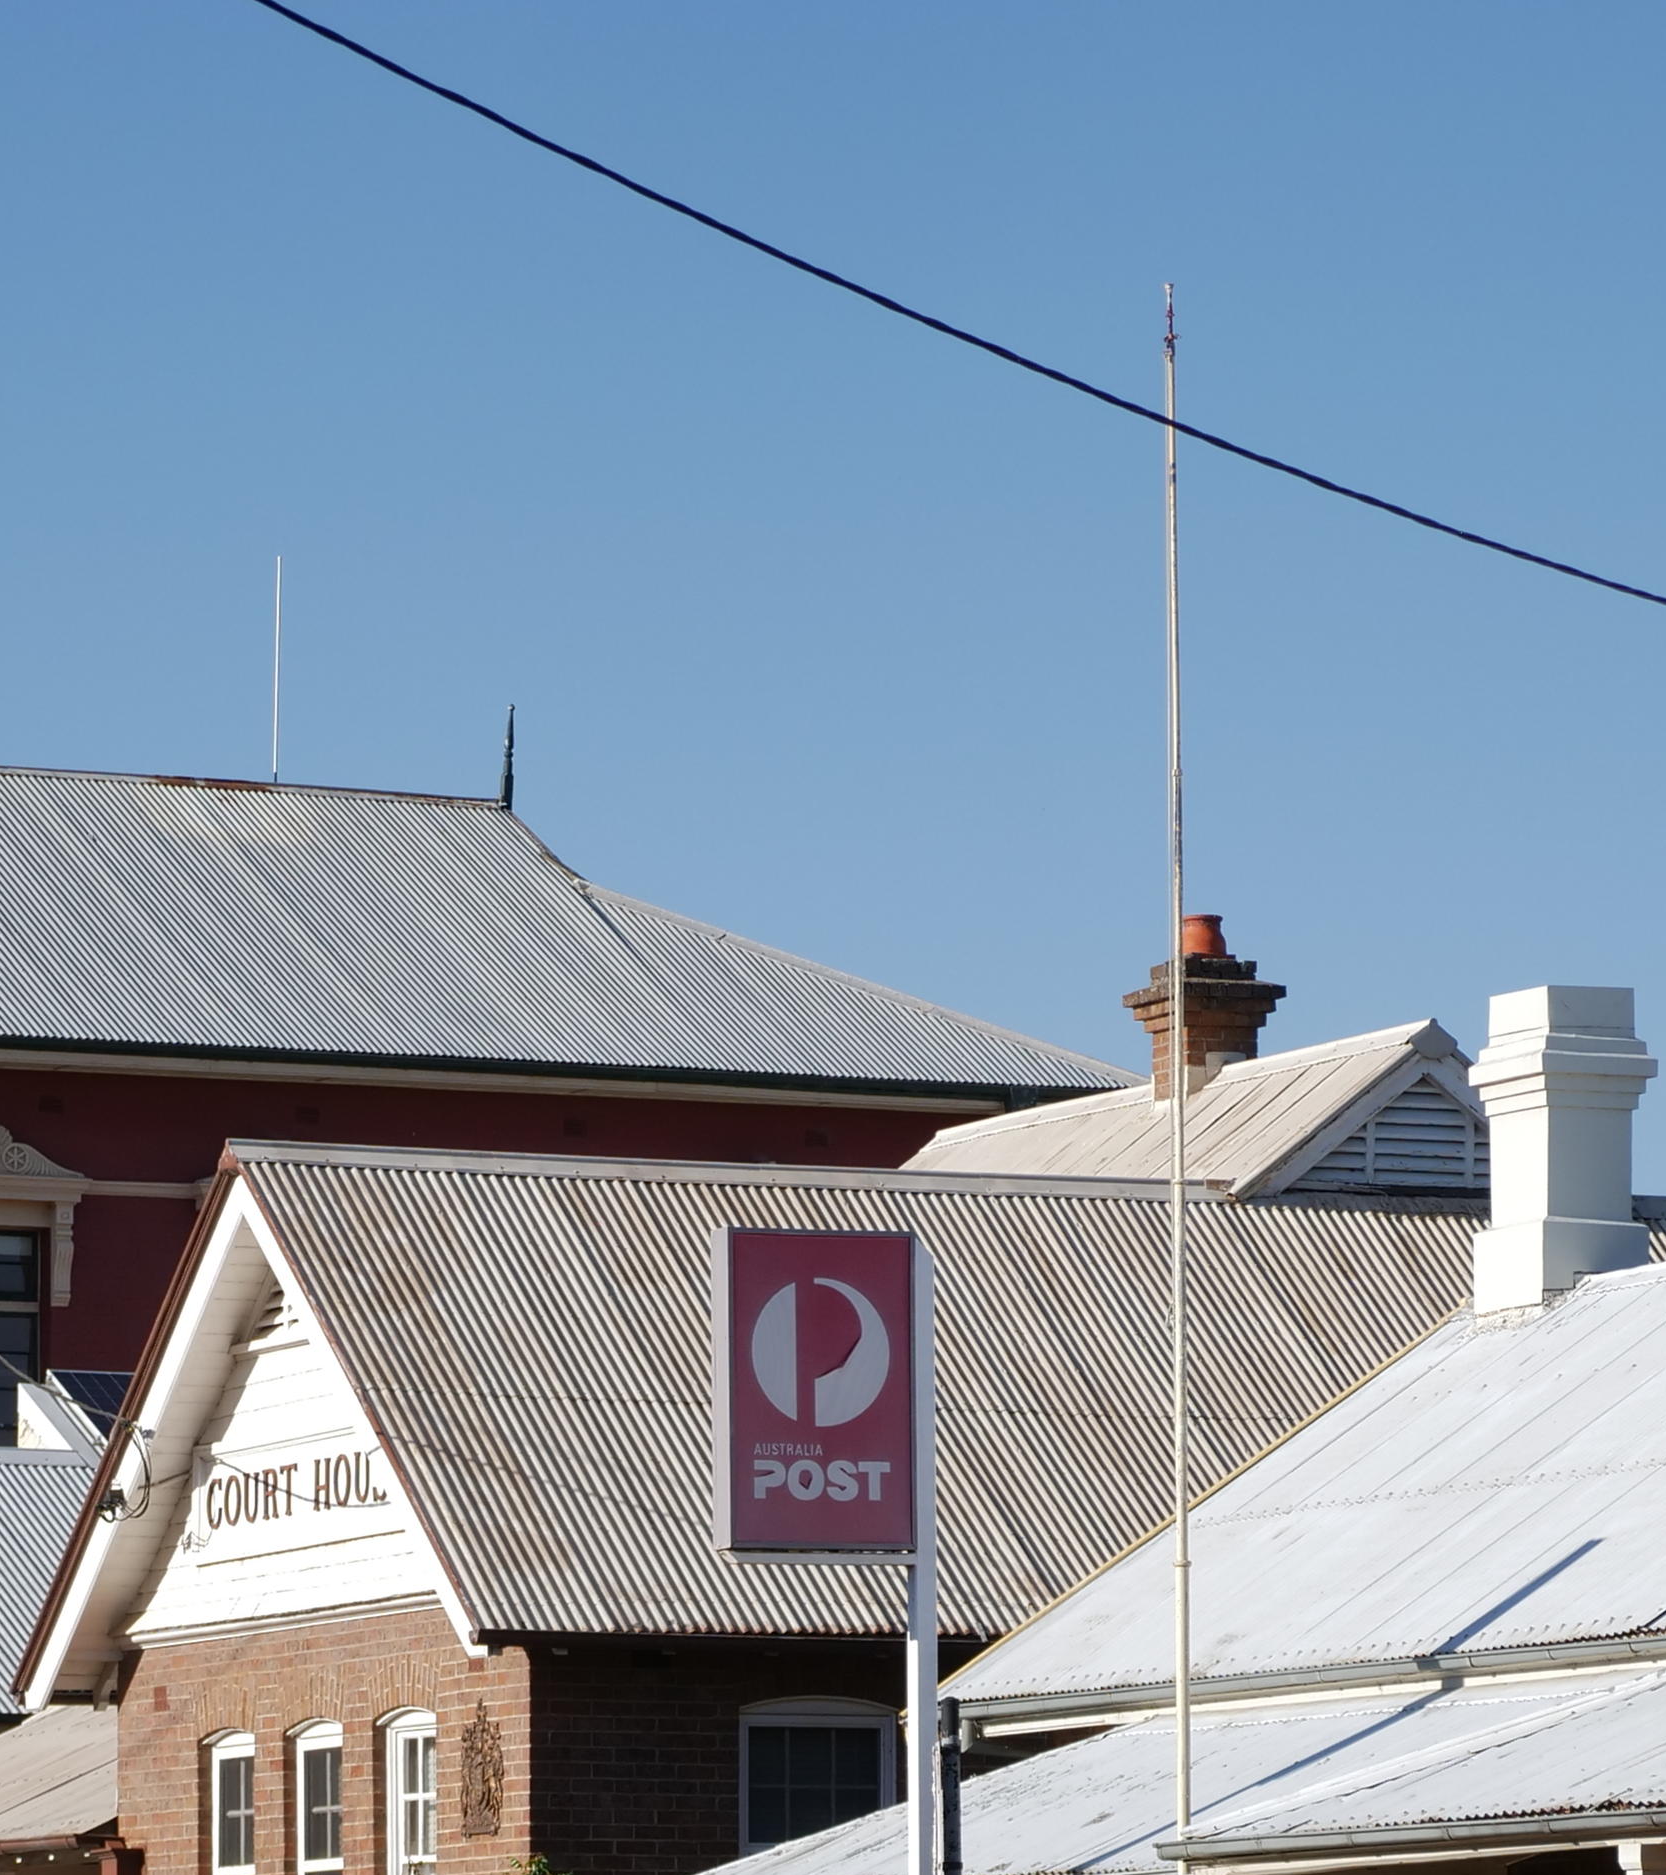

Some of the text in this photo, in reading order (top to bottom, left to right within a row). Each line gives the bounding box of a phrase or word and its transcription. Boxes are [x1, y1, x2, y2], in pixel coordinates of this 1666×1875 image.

[753, 1443, 823, 1457] AUSTRALIA
[206, 1463, 298, 1530] COURT
[753, 1459, 891, 1502] POST
